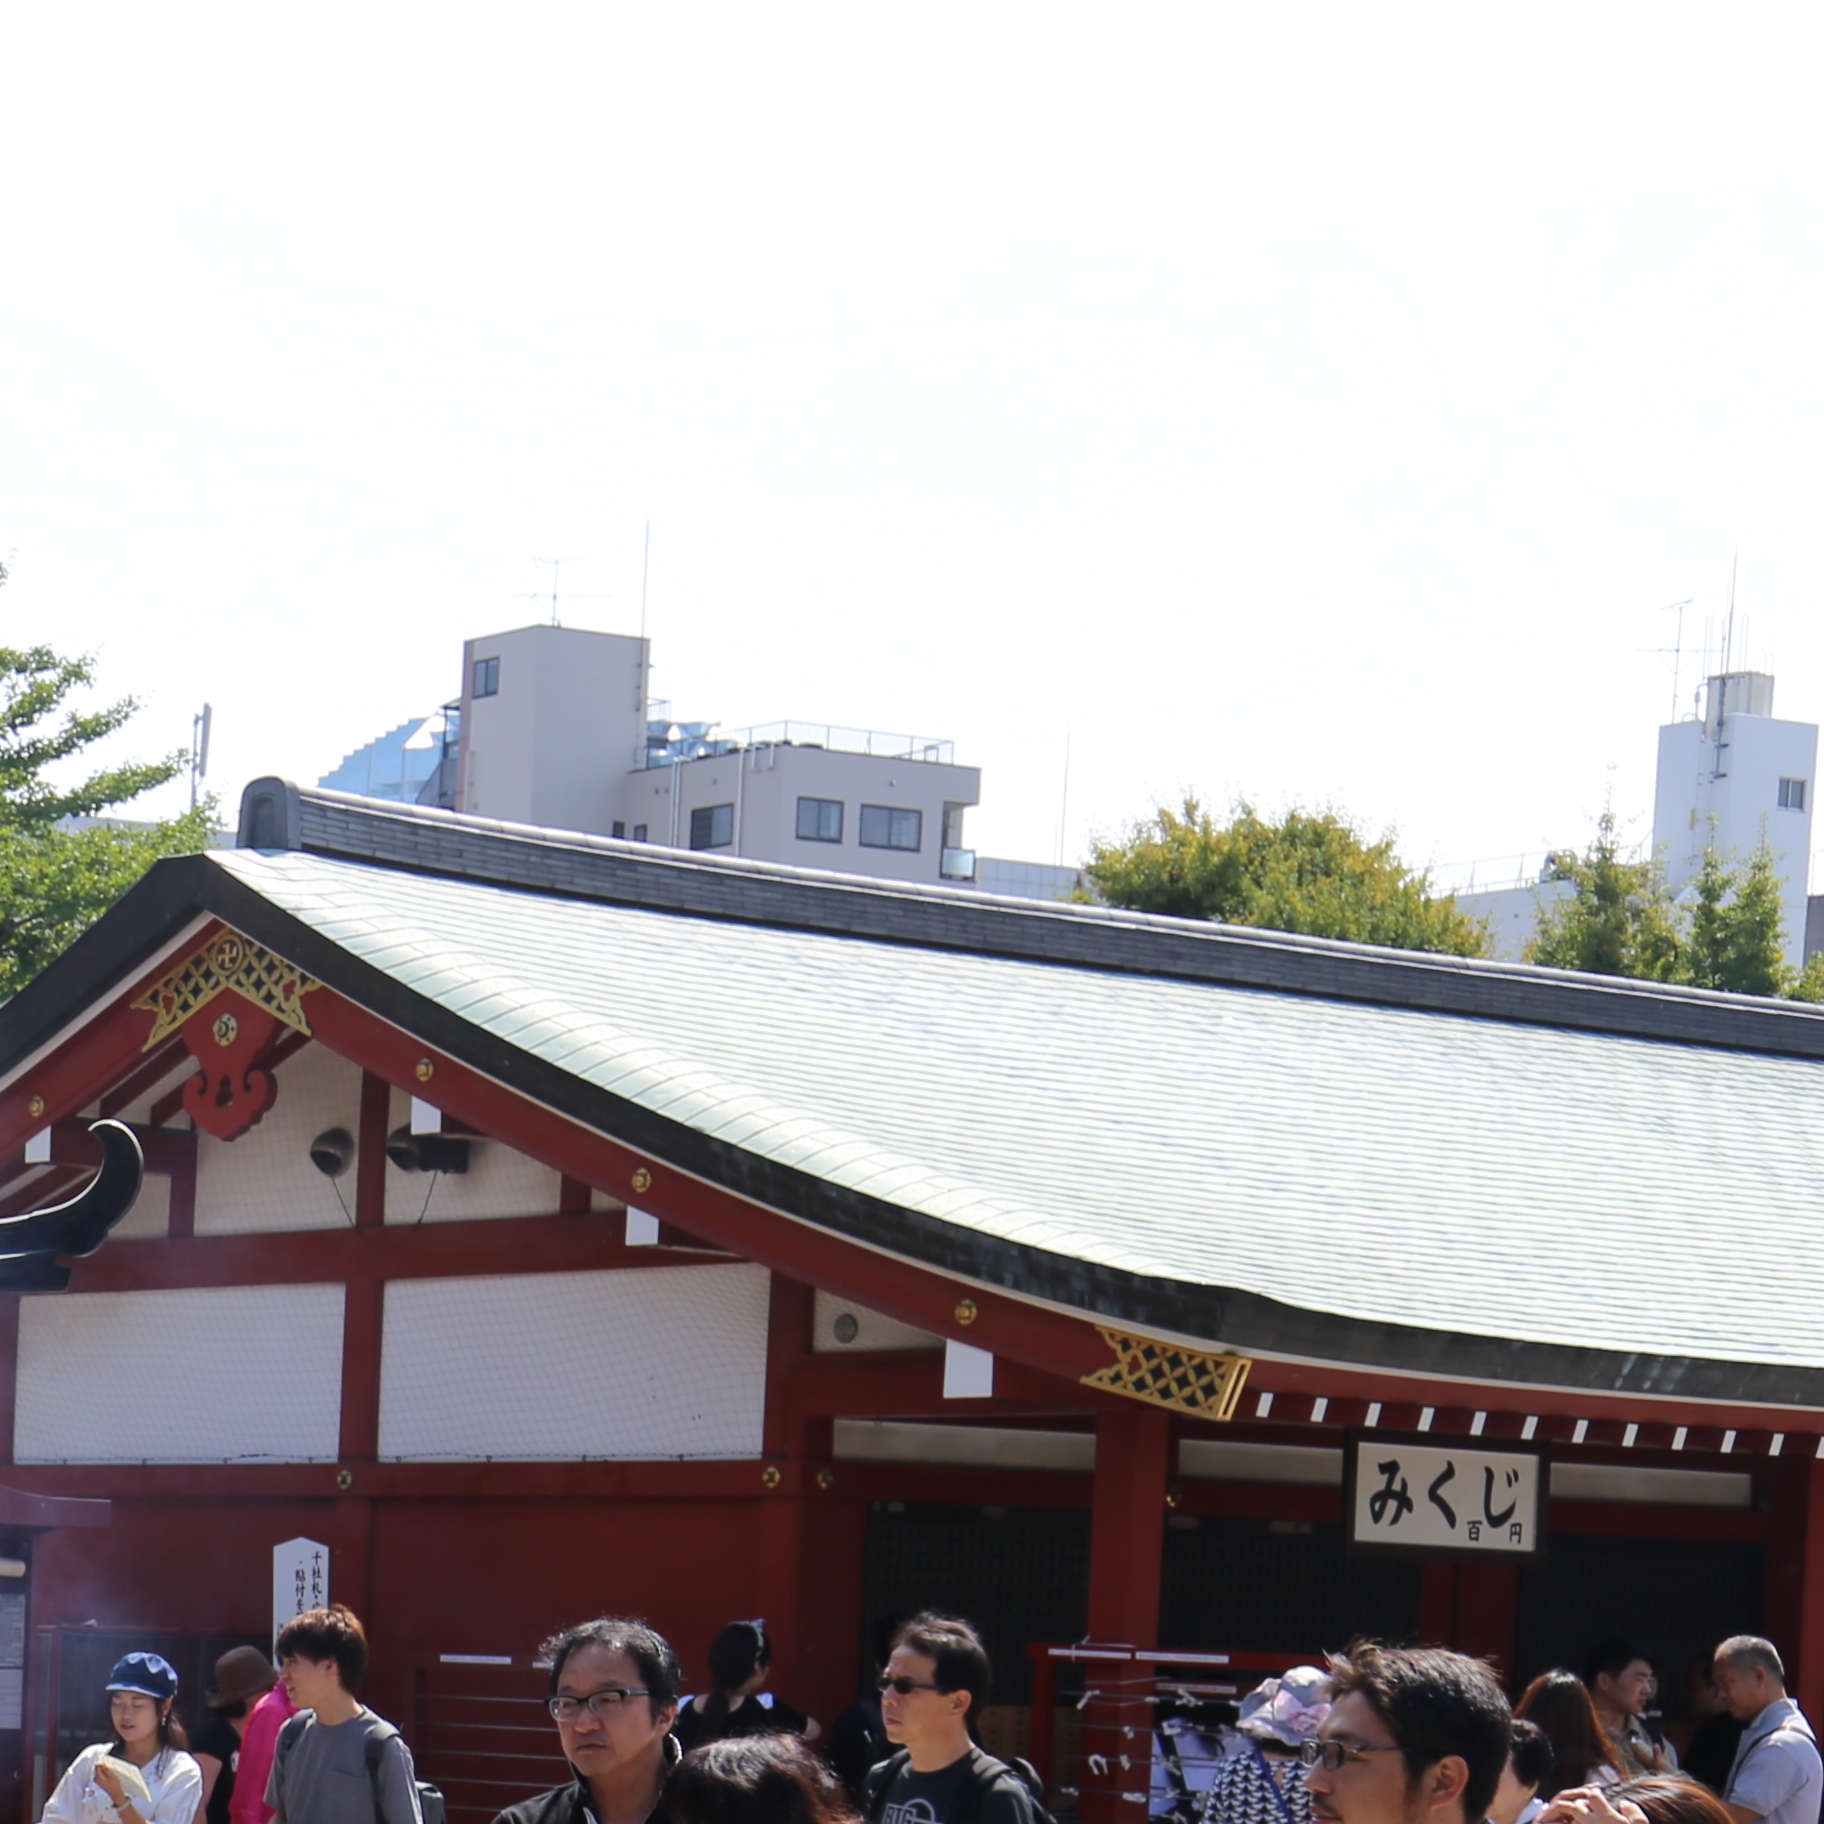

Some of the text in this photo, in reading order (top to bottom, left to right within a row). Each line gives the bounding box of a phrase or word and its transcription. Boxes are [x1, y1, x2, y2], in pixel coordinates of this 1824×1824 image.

[1369, 1459, 1520, 1530] みくじ
[1466, 1519, 1523, 1545] 百円
